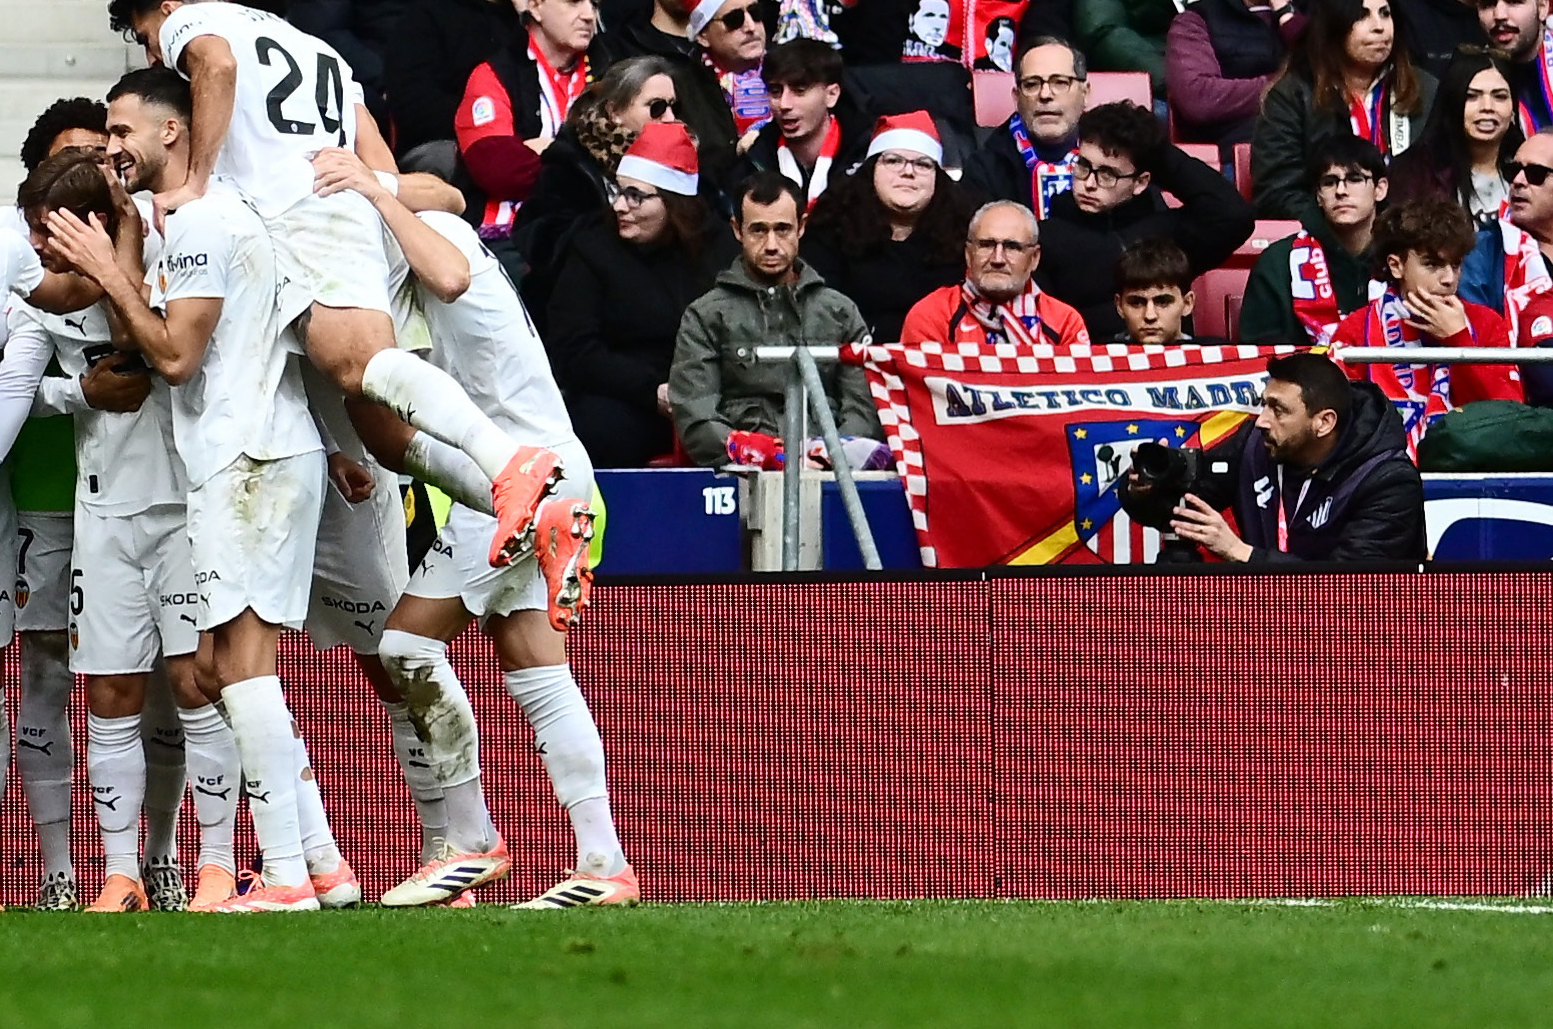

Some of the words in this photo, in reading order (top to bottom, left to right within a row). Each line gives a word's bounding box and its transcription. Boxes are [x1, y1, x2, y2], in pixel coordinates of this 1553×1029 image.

[255, 36, 347, 148] 24
[946, 383, 1131, 418] ATLETICO
[702, 488, 736, 515] 113
[160, 593, 197, 607] SKOD
[22, 726, 47, 738] VCF
[197, 775, 224, 787] VCF
[247, 780, 263, 789] CF
